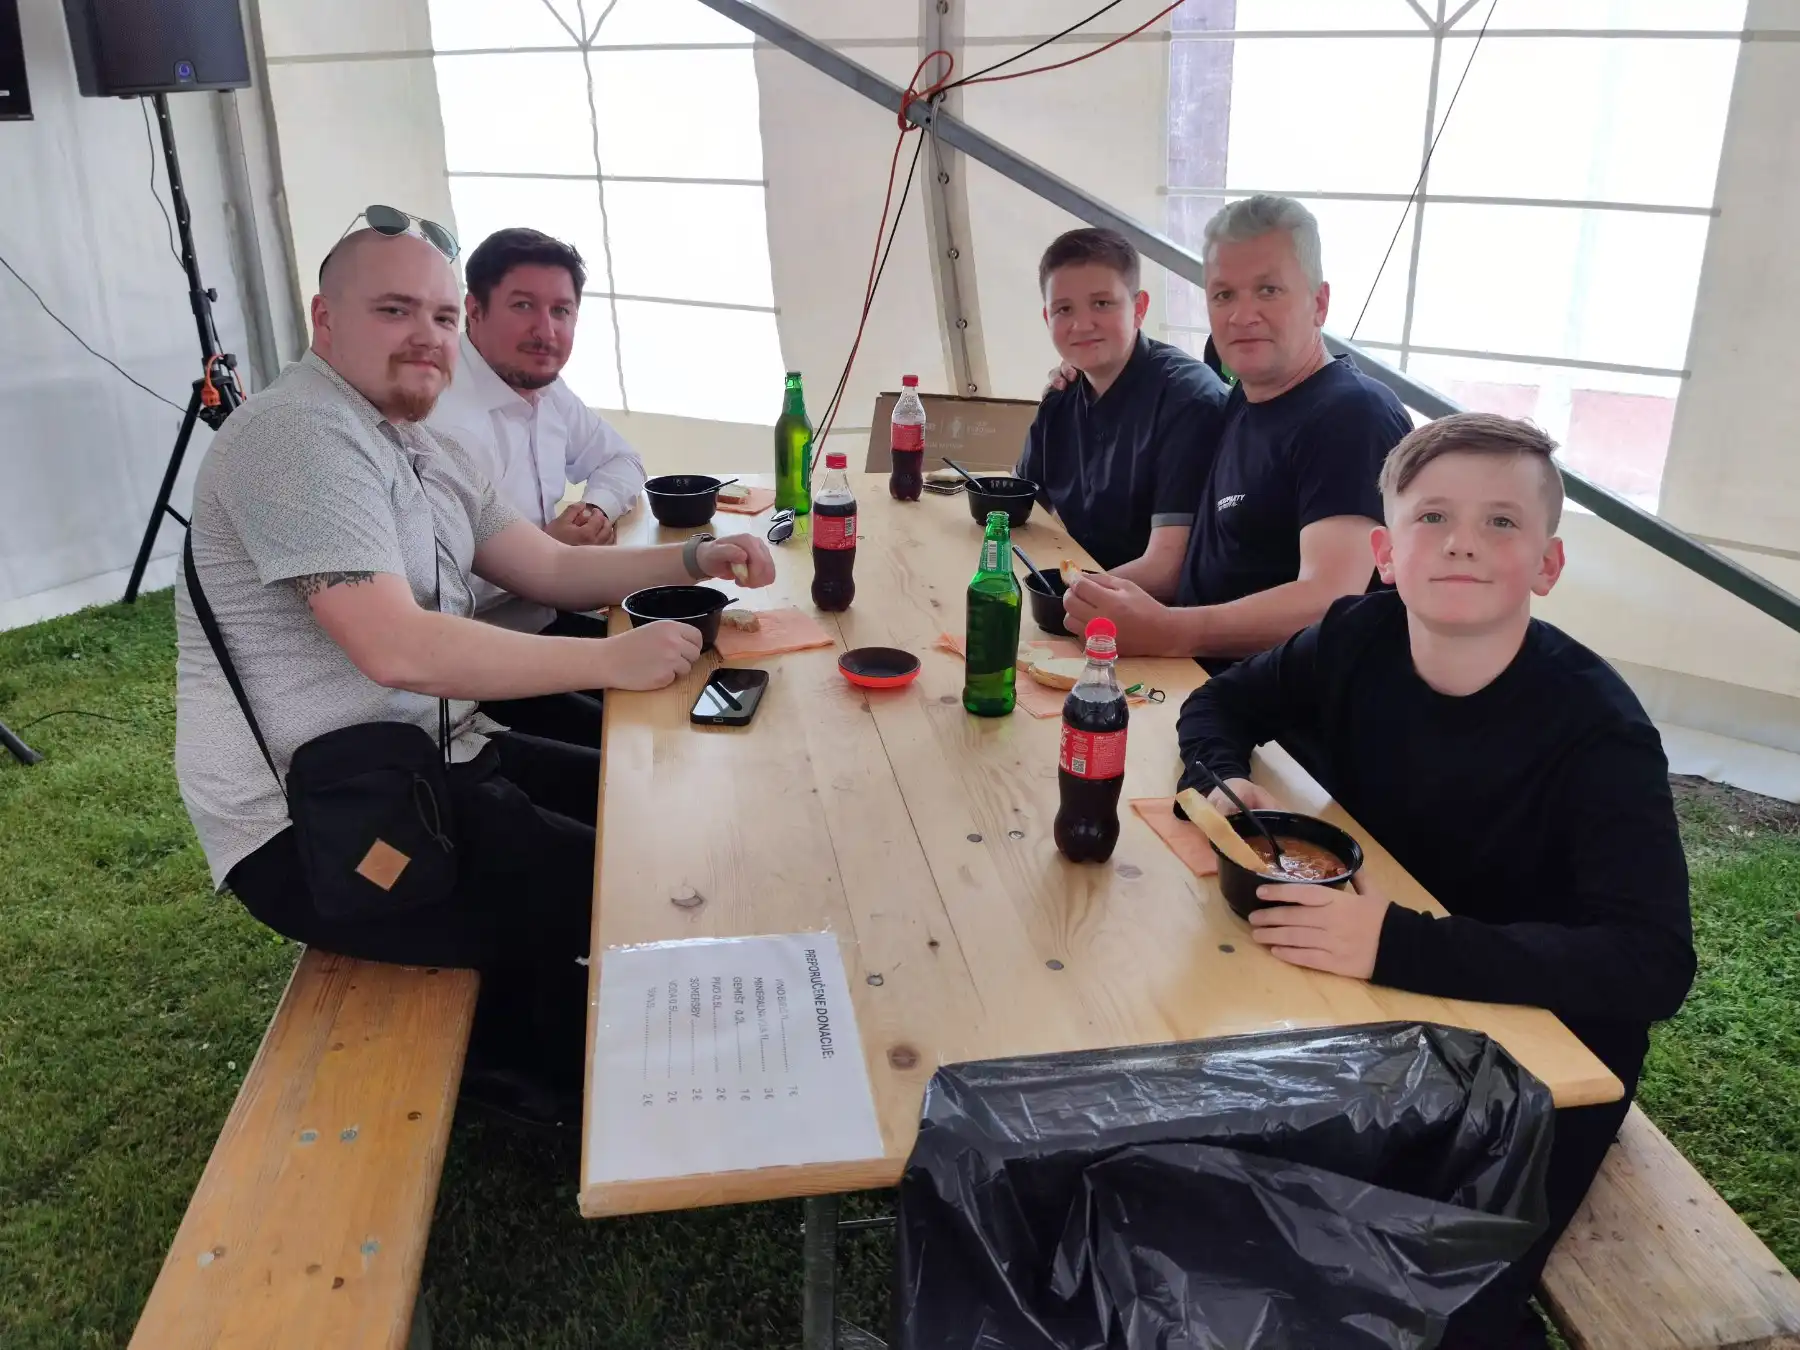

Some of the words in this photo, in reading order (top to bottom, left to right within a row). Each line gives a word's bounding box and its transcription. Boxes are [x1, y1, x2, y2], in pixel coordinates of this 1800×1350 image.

[689, 976, 701, 1018] SOMERSBY
[711, 976, 721, 994] PIVO
[732, 976, 745, 1004] GEMIŠT
[804, 949, 826, 1006] PREPORUČENE
[816, 1007, 835, 1059] DONACIJE:
